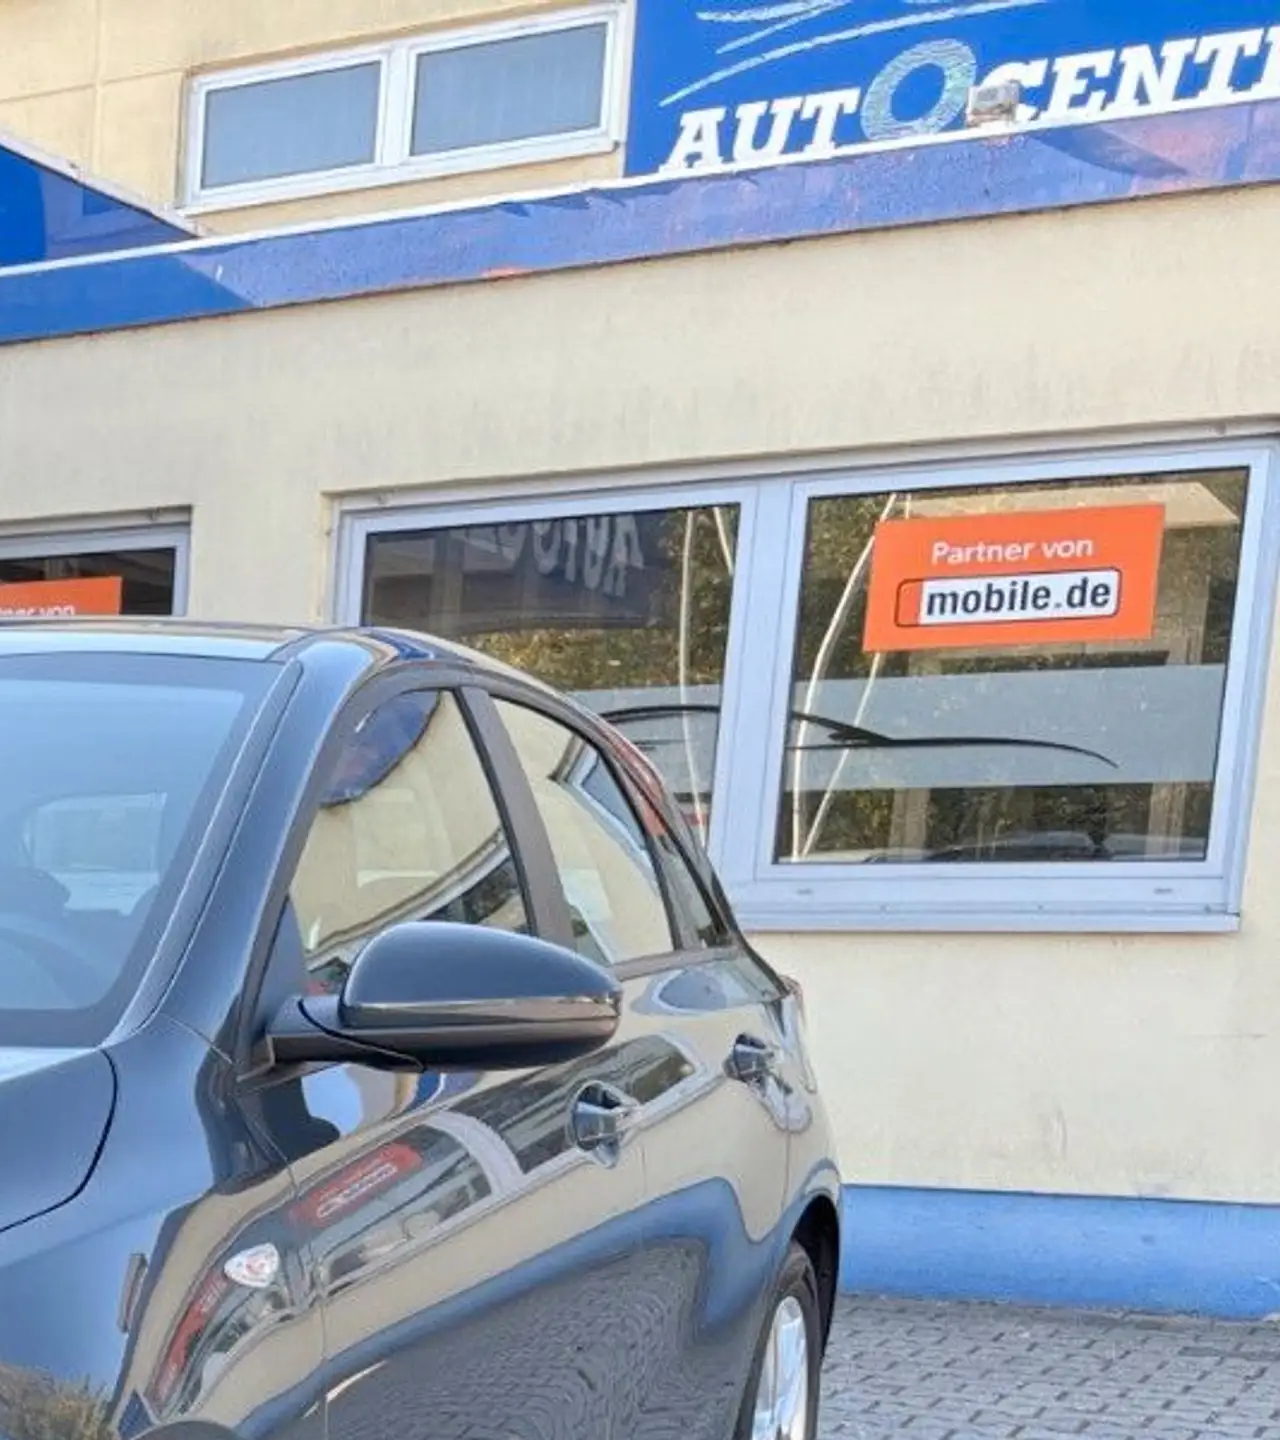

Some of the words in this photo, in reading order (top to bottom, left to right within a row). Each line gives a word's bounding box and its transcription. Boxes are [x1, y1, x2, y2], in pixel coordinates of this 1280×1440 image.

[932, 541, 1035, 565] Partner
[1042, 538, 1094, 561] von
[926, 576, 1111, 617] mobile.de
